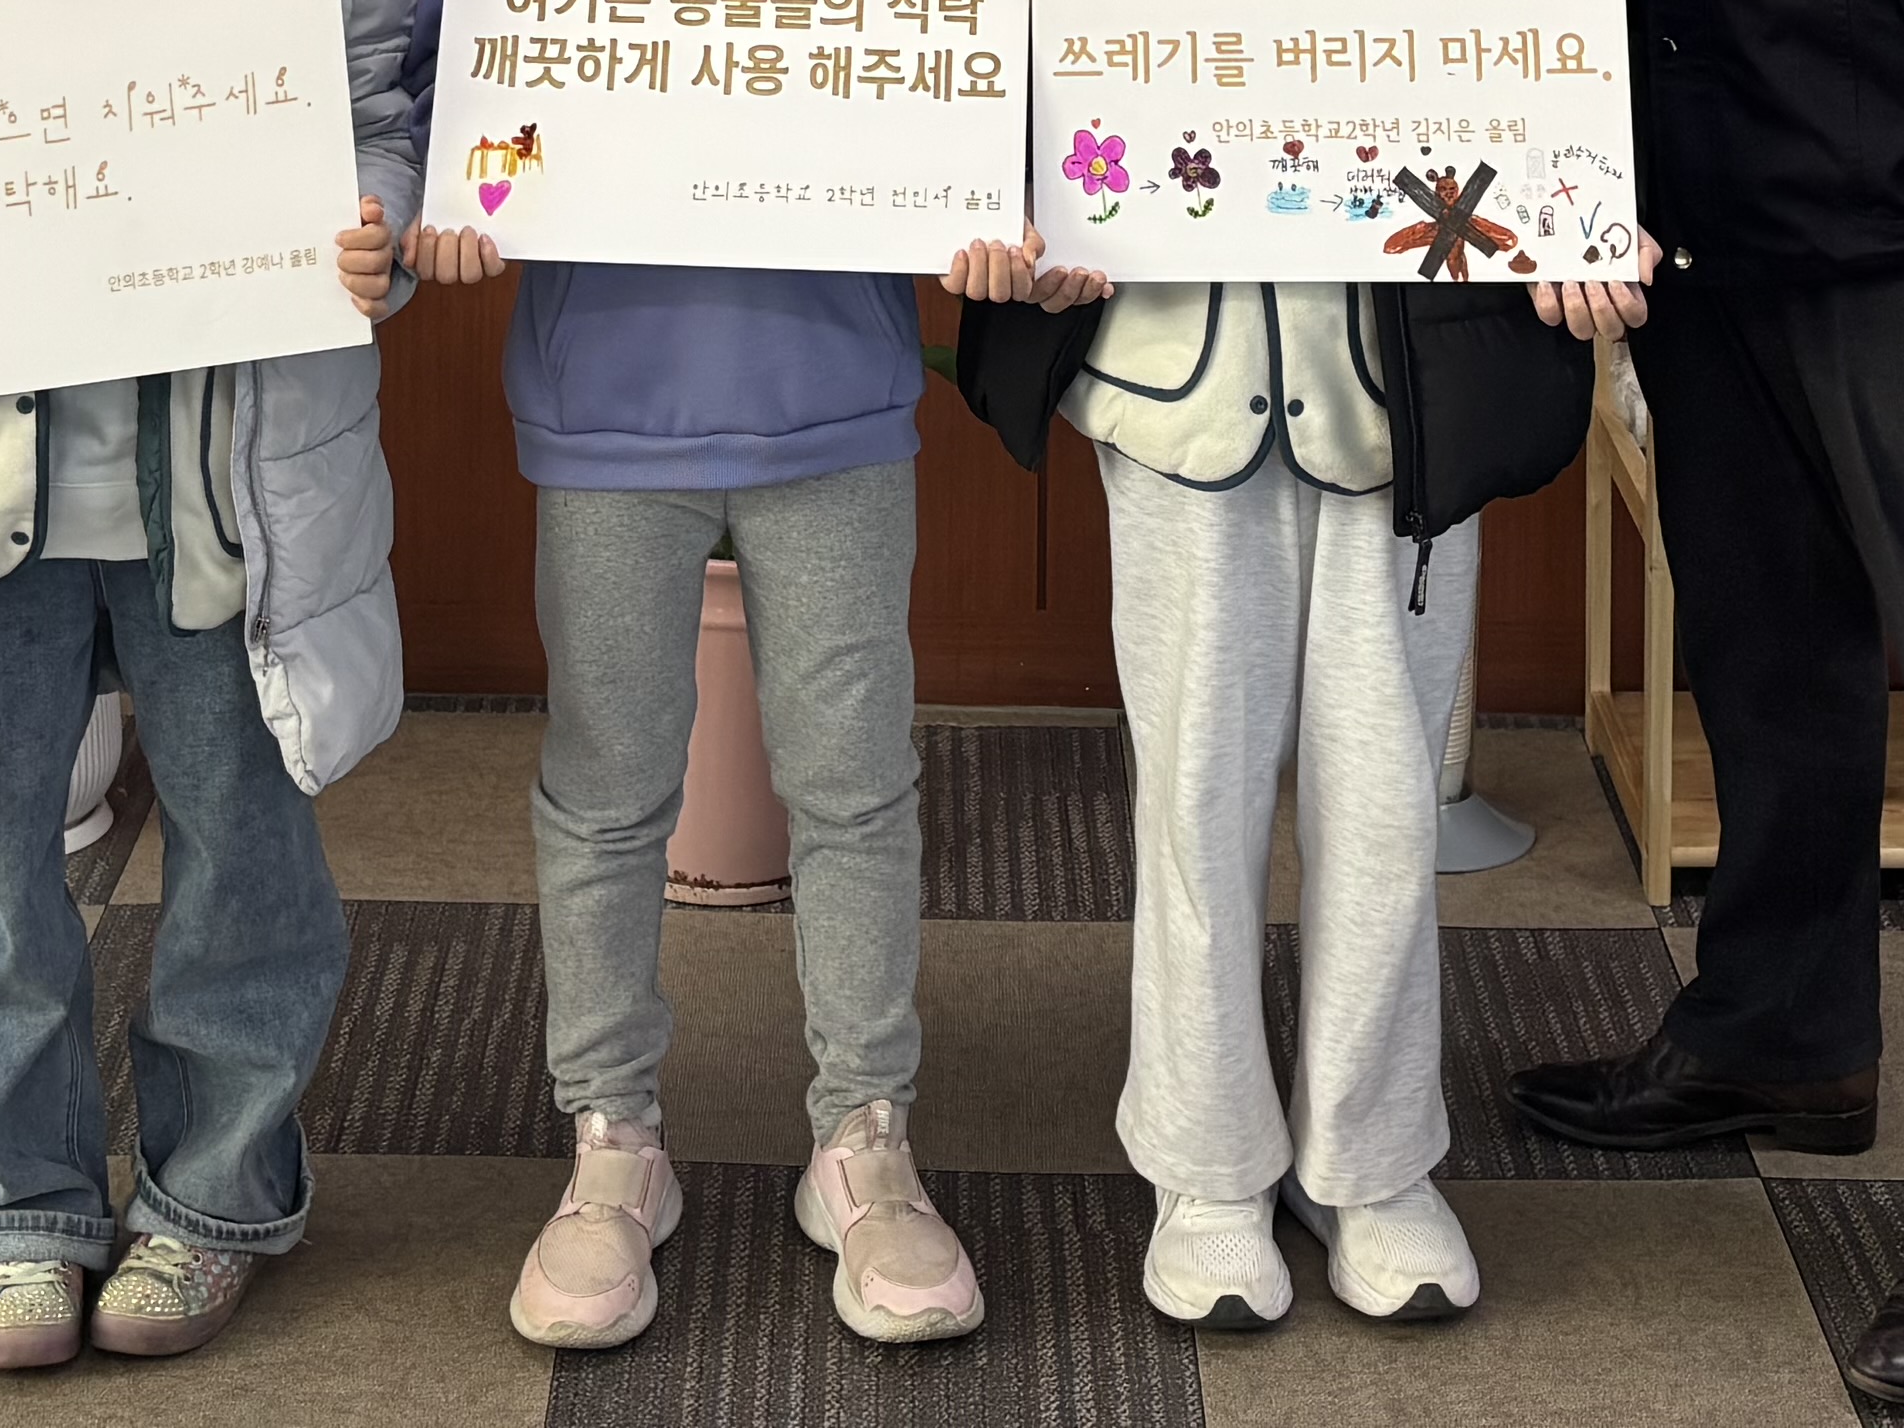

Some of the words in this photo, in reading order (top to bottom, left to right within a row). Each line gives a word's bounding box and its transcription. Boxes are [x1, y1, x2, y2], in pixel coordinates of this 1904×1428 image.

[471, 35, 670, 93] 깨끗하게
[691, 42, 789, 96] 사용
[808, 46, 1006, 102] 해주세요
[1053, 31, 1254, 87] 쓰레기를
[1273, 29, 1415, 83] 버리지
[1439, 28, 1612, 82] 마세요.
[103, 67, 313, 132] 치워주세요.
[1410, 119, 1475, 144] 김지은
[1485, 118, 1527, 143] 올림
[692, 180, 811, 203] 안의초등학교
[826, 185, 875, 206] 2학년
[108, 266, 194, 292] 안의초등학교
[200, 260, 236, 279] 2학년
[290, 247, 317, 268] 올림
